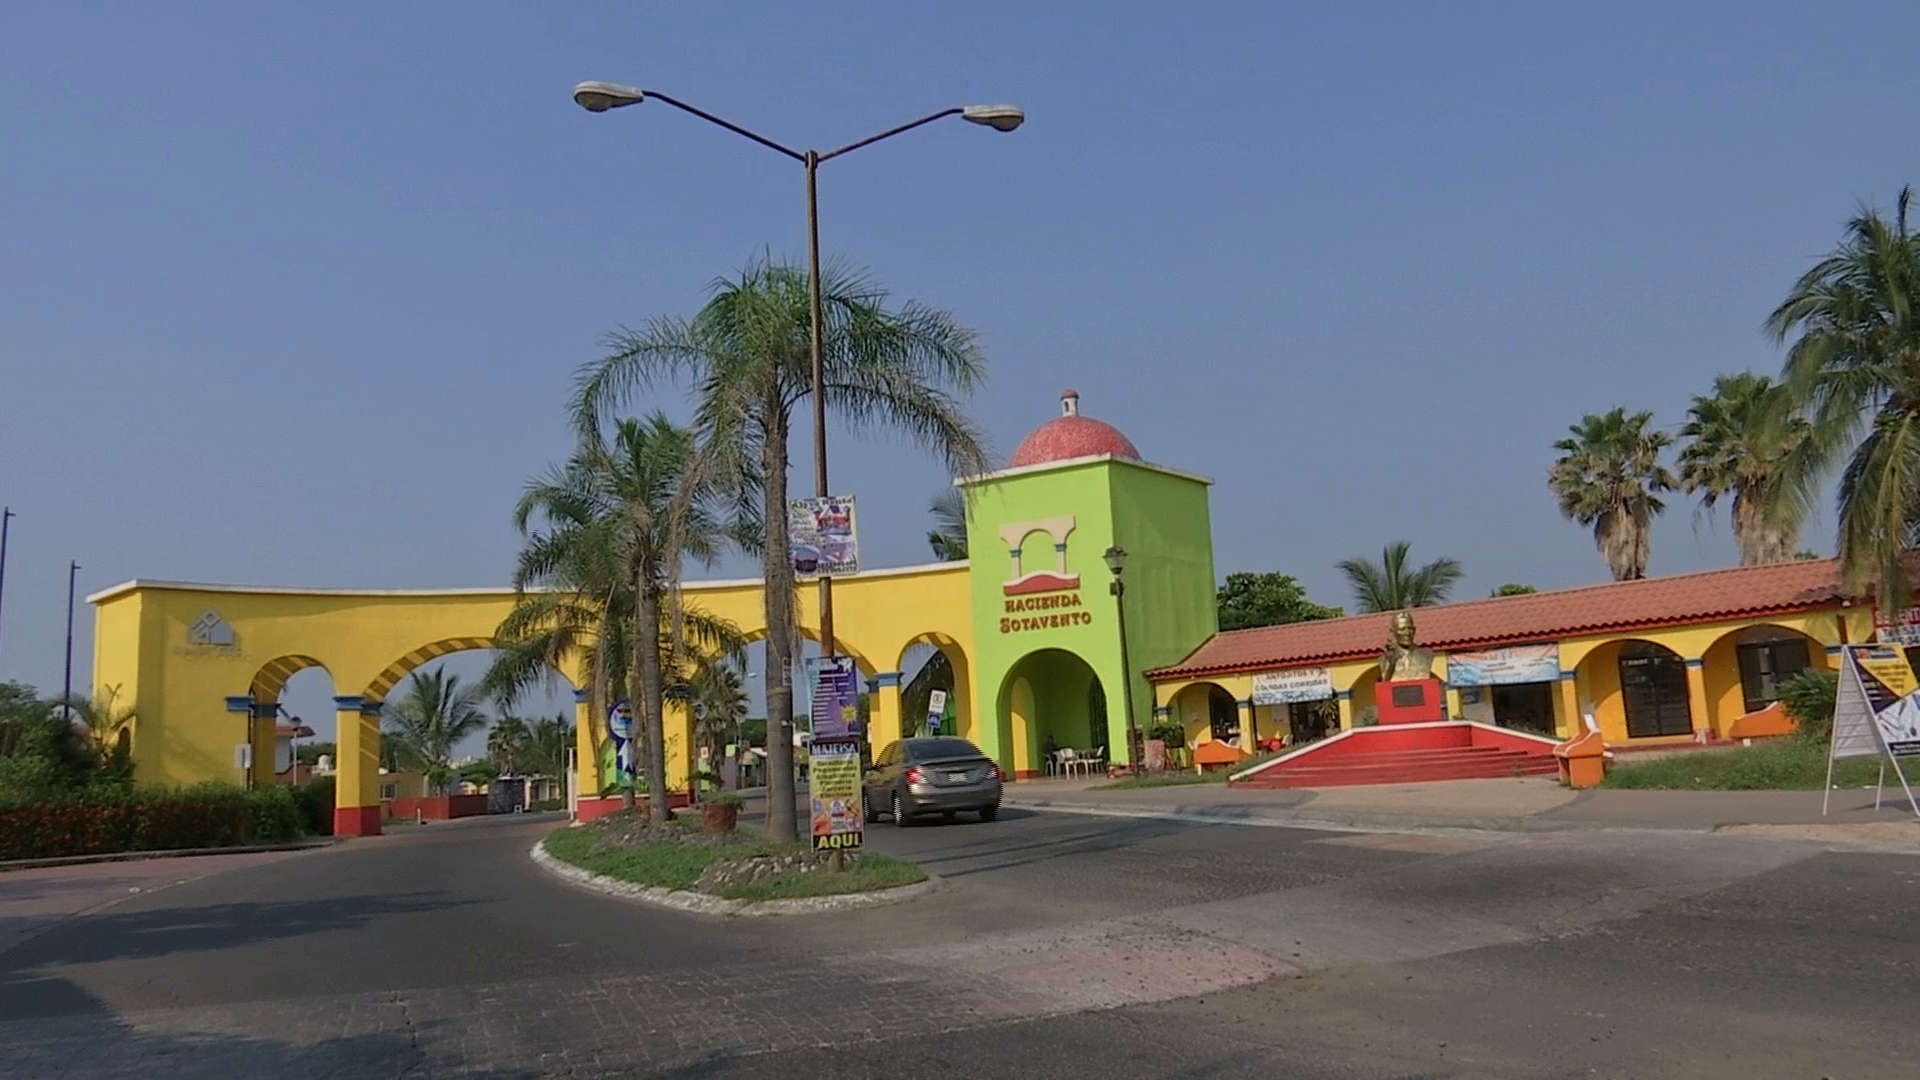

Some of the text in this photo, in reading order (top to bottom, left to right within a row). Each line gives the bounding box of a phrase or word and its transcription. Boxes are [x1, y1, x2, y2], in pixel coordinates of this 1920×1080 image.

[1005, 593, 1082, 613] HACIENDA
[1000, 611, 1092, 634] SOTAVENTO
[818, 833, 860, 850] AQUI
